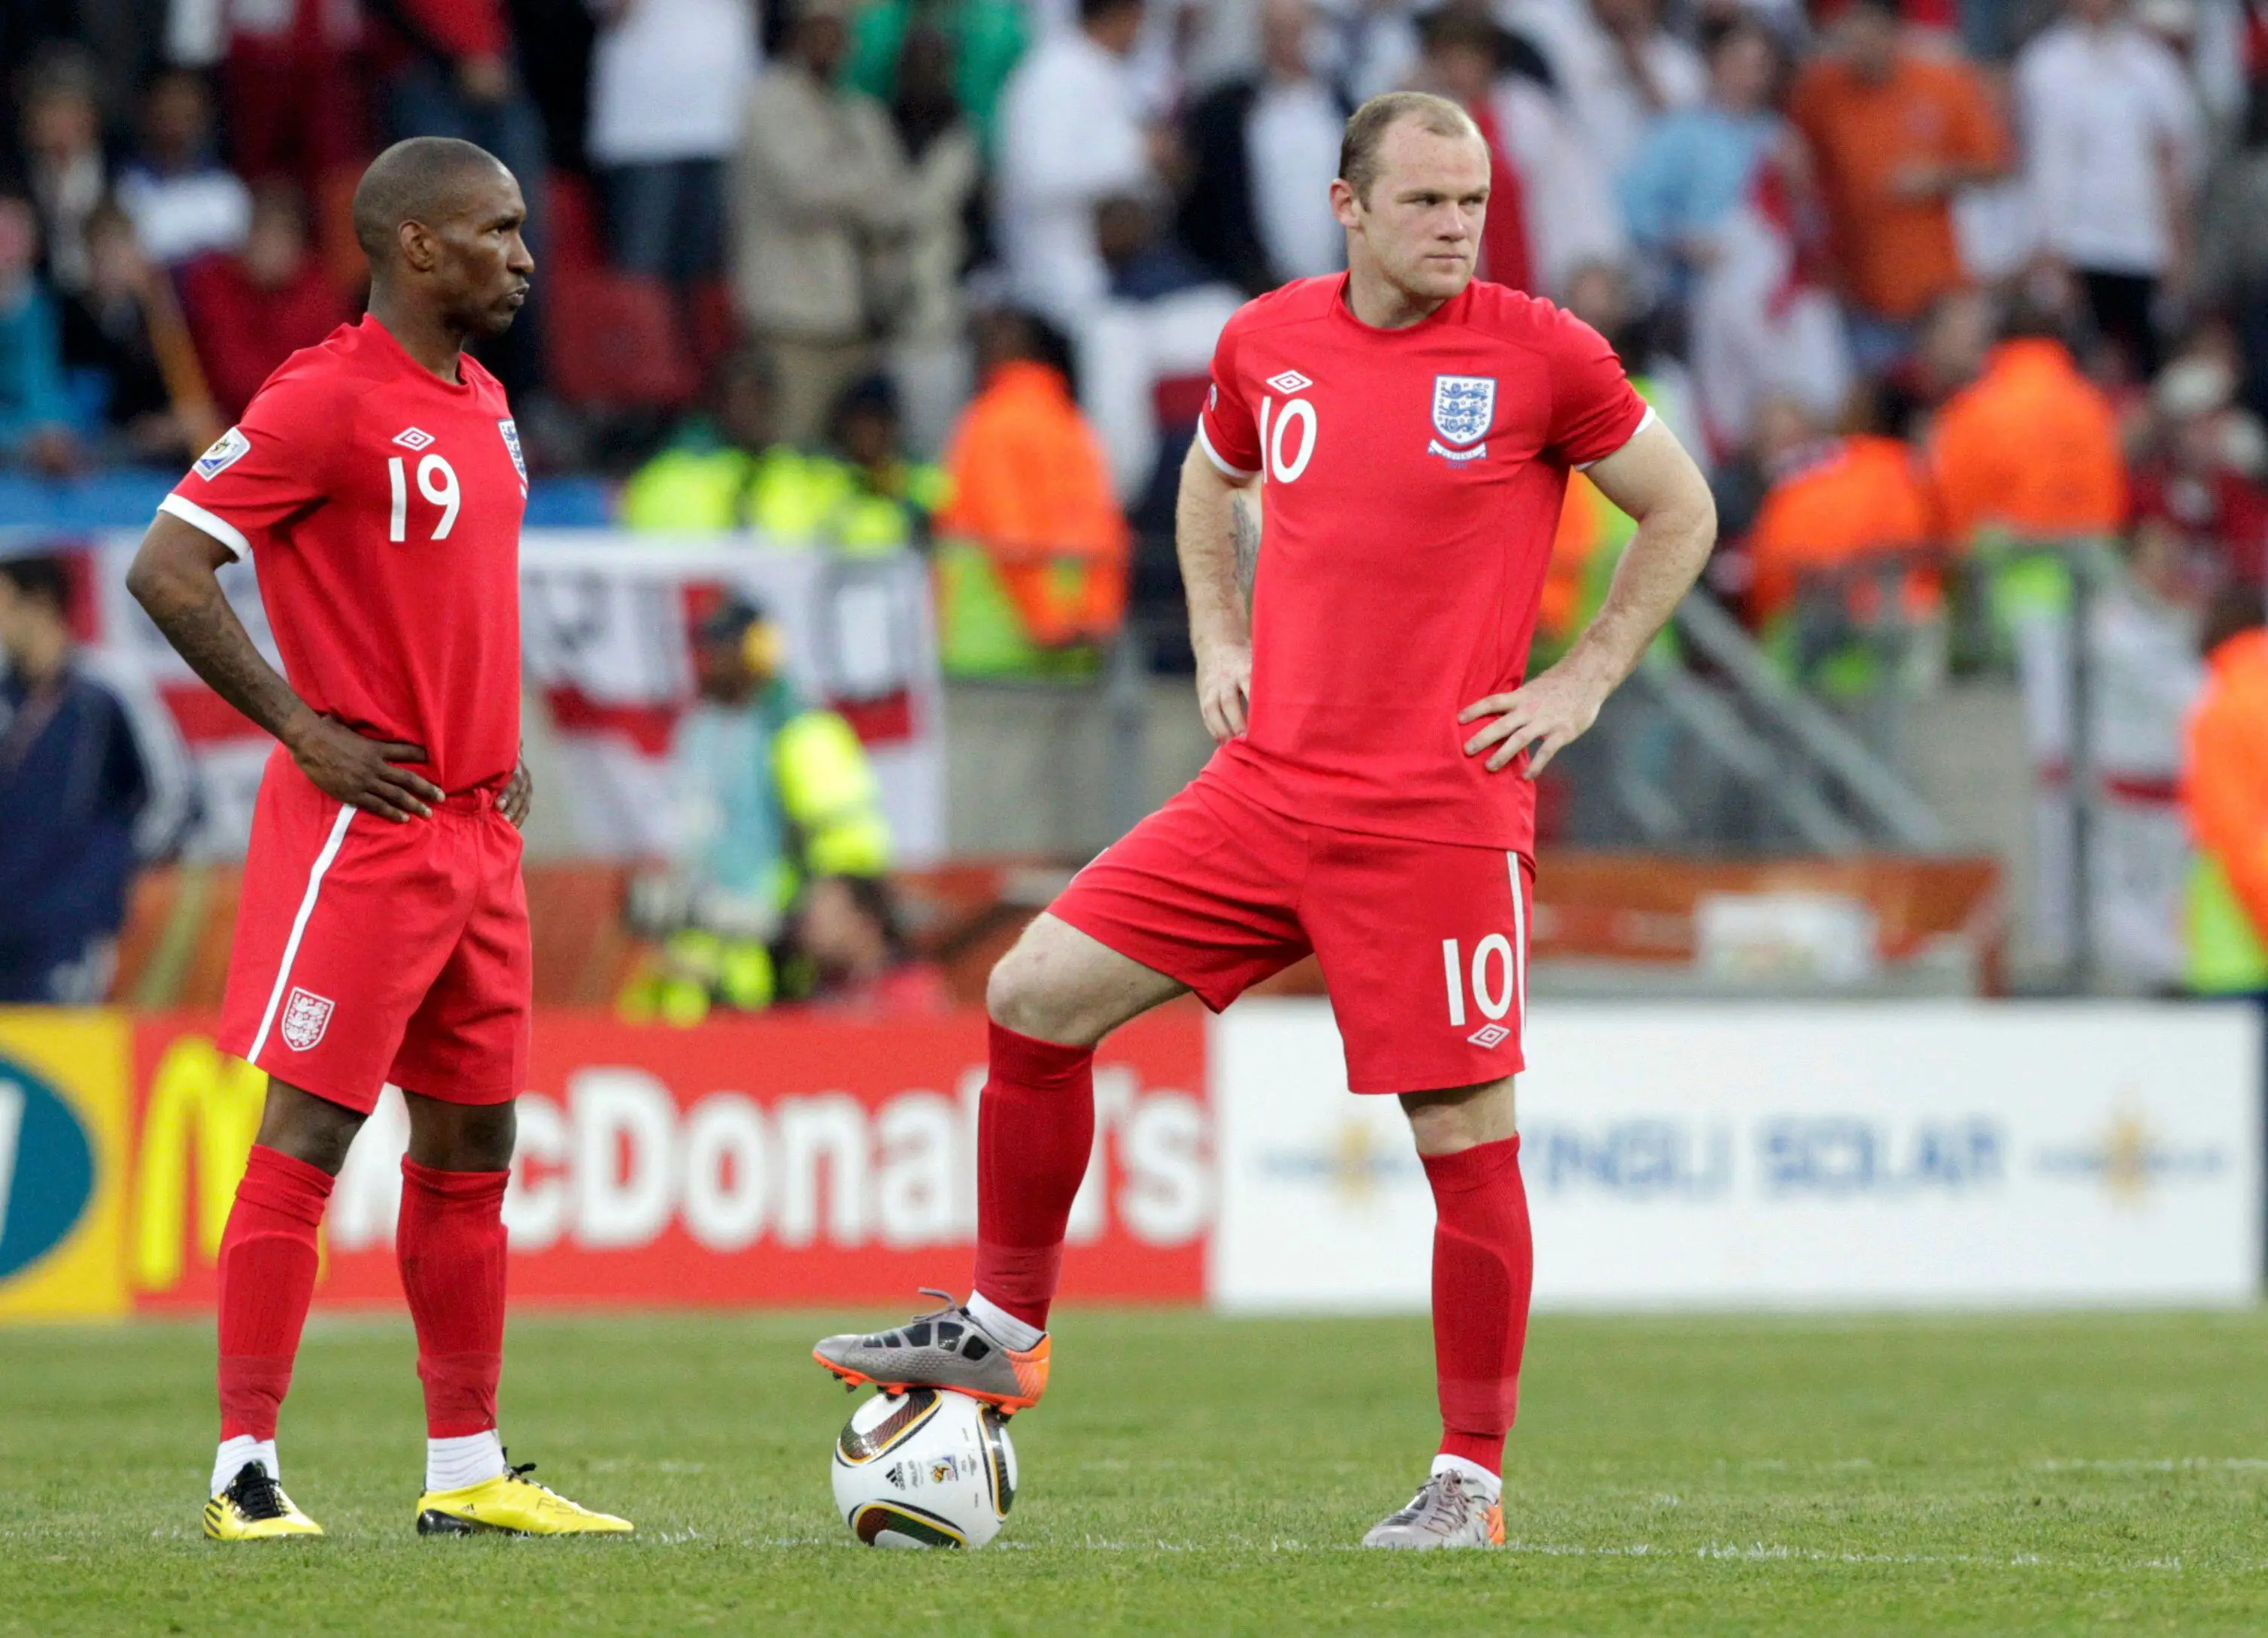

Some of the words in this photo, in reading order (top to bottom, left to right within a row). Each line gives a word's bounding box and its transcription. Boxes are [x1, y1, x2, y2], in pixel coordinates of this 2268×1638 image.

[1261, 396, 1317, 484] 10
[388, 453, 460, 541] 19
[1443, 933, 1514, 1026] 10
[1755, 1116, 2010, 1197] SOLAR
